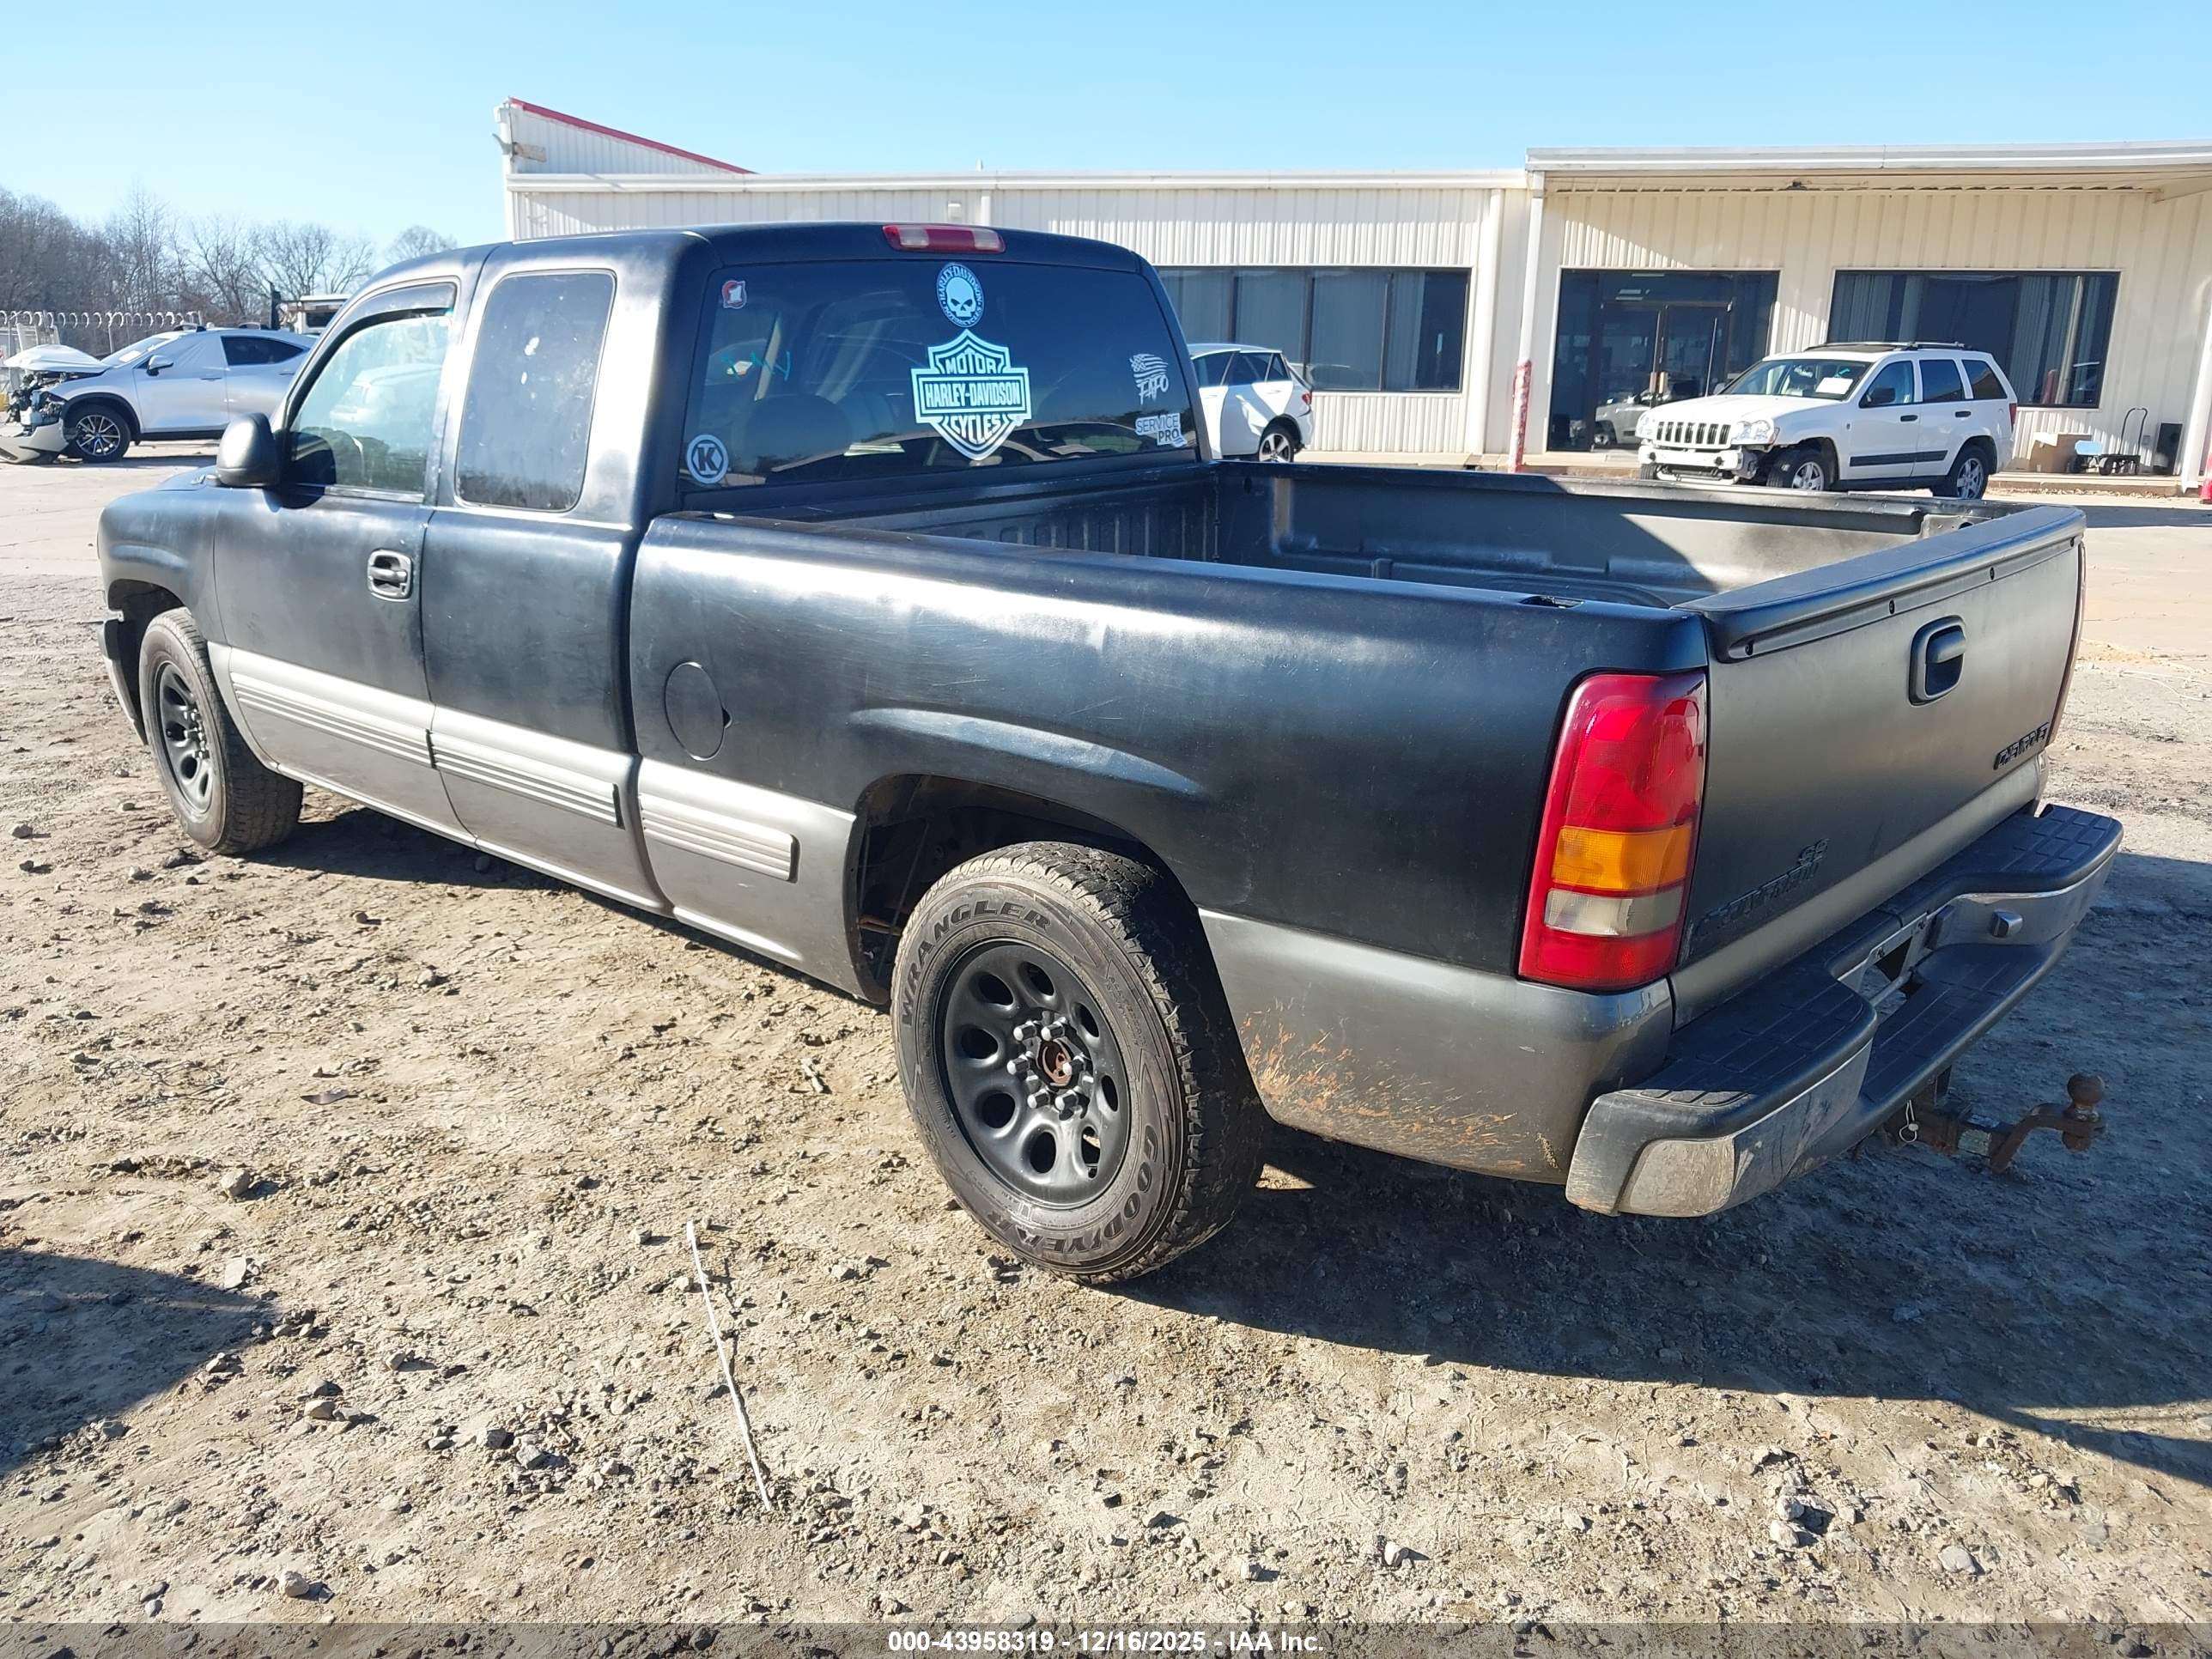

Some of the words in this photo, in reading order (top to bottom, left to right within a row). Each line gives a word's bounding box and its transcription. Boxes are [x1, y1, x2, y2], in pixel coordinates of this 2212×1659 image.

[945, 347, 997, 375] MOTOR
[924, 380, 1021, 409] HARLEY-DAVIDSON
[1136, 374, 1169, 405] FAFO
[949, 413, 1002, 446] CYCLES
[1135, 415, 1180, 434] SERVICE
[1158, 428, 1180, 443] PRO
[696, 447, 720, 472] K
[902, 900, 1051, 1026] WRANGLER
[985, 1125, 1158, 1255] GOODYEAR
